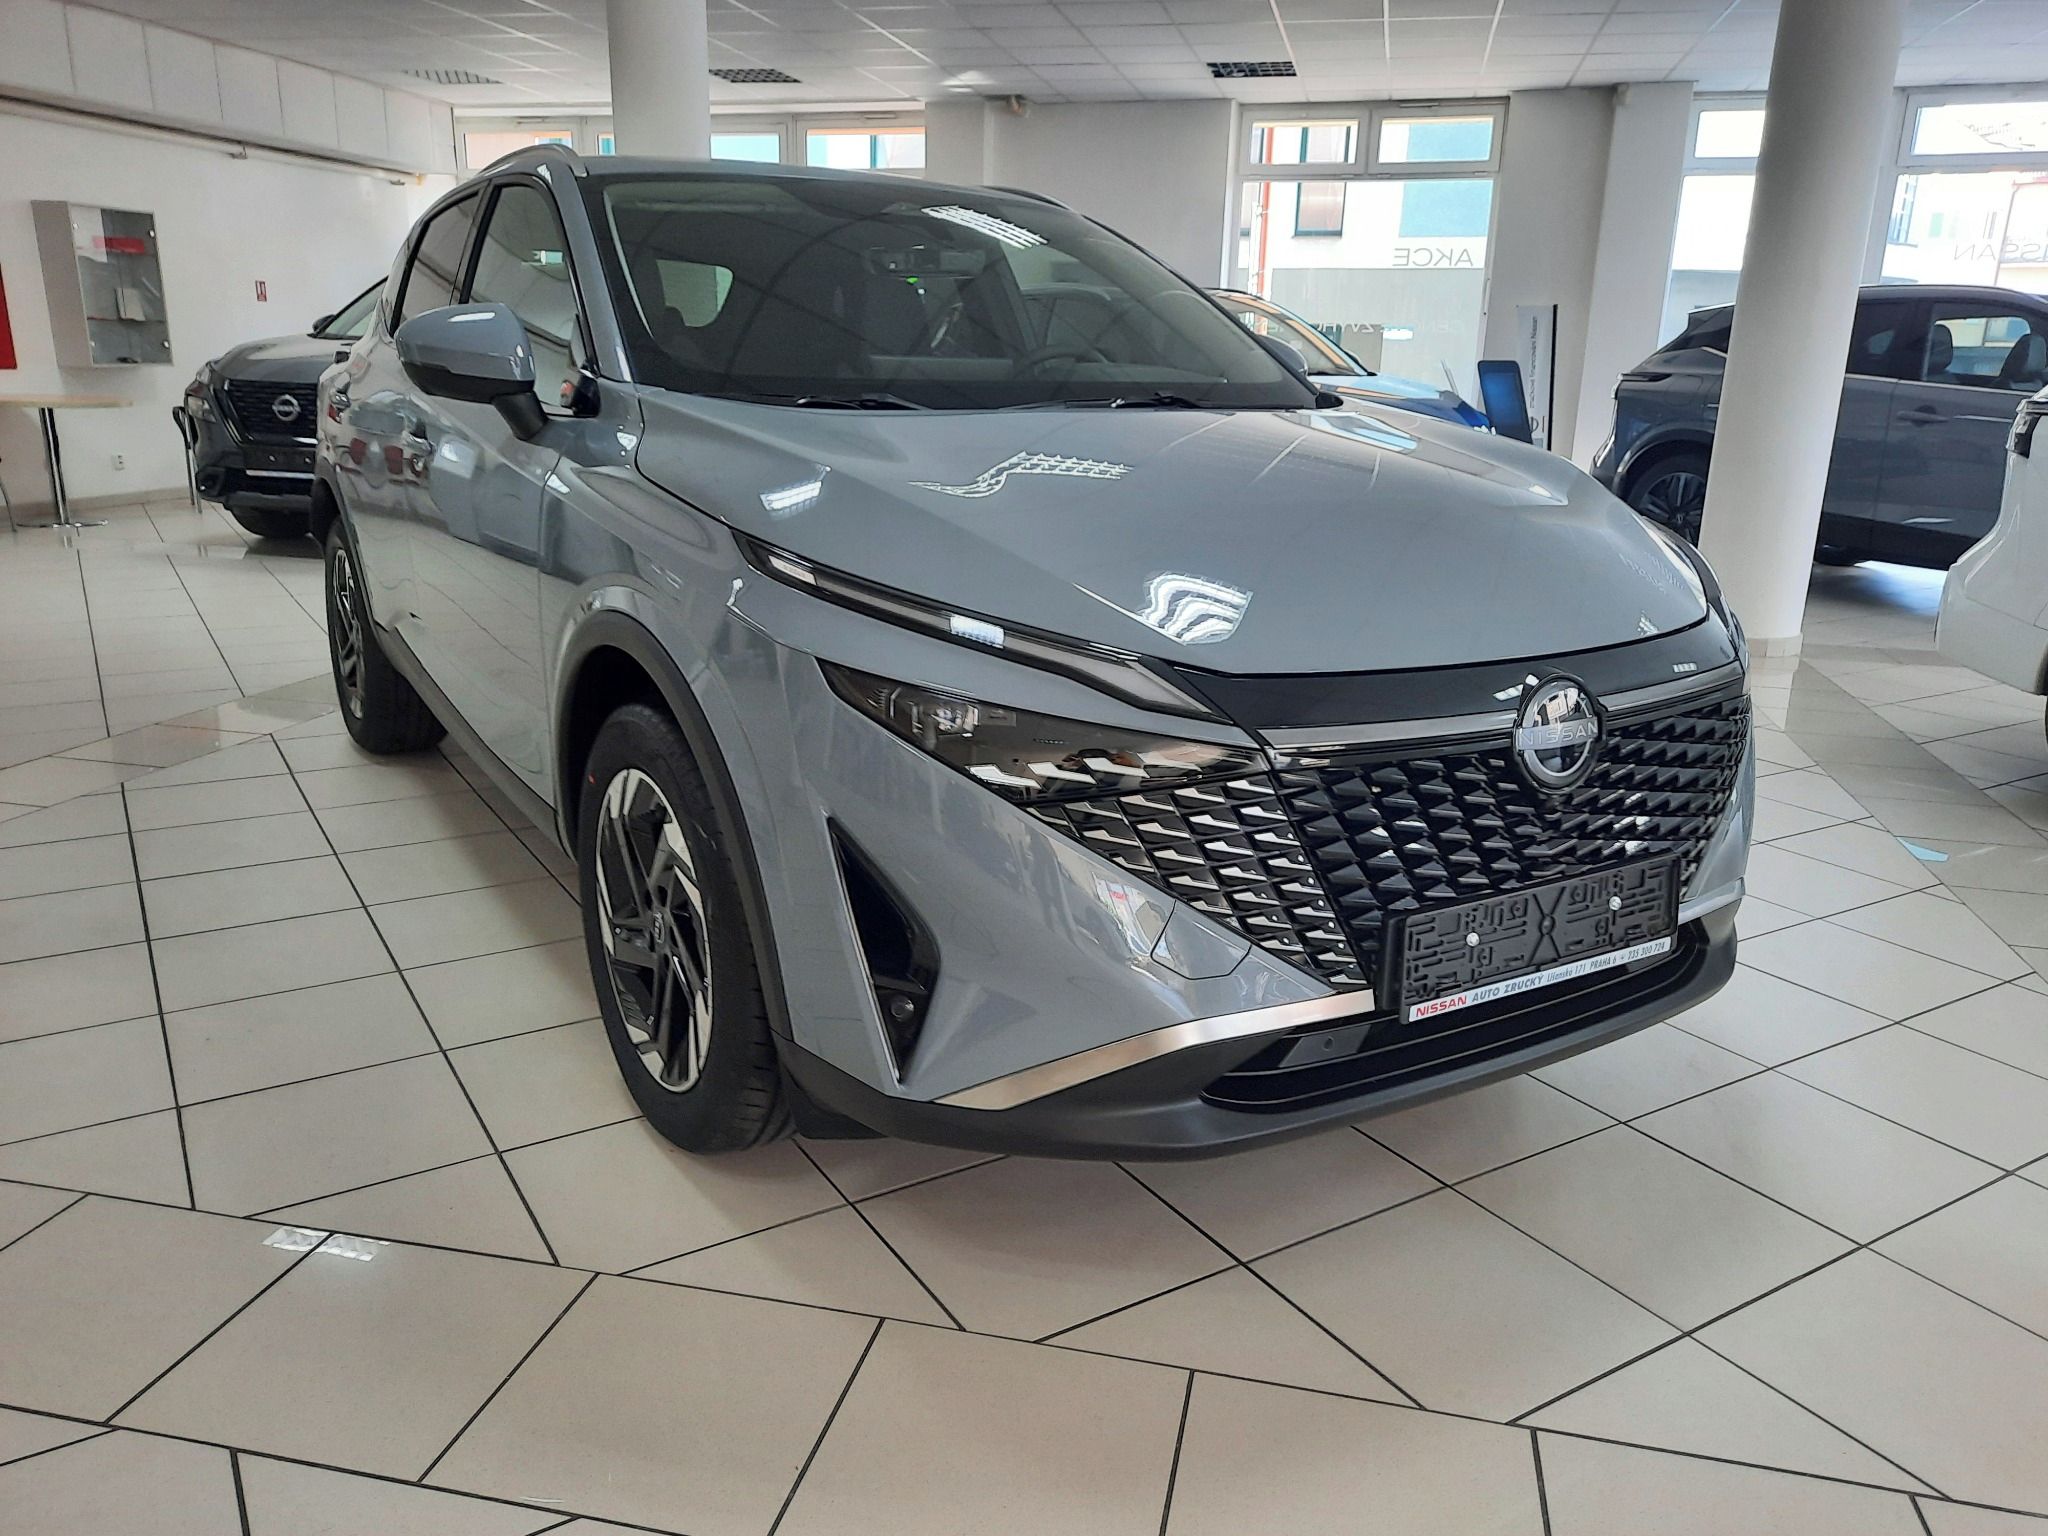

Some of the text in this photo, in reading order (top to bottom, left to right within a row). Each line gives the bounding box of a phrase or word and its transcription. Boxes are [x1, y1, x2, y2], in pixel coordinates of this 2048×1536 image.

[1520, 721, 1598, 746] NISSAN
[1416, 995, 1467, 1017] NISSAN
[1471, 986, 1500, 1003] AUTO
[1503, 974, 1545, 994] ZRUCKÝ
[1590, 956, 1611, 971] PRAHA
